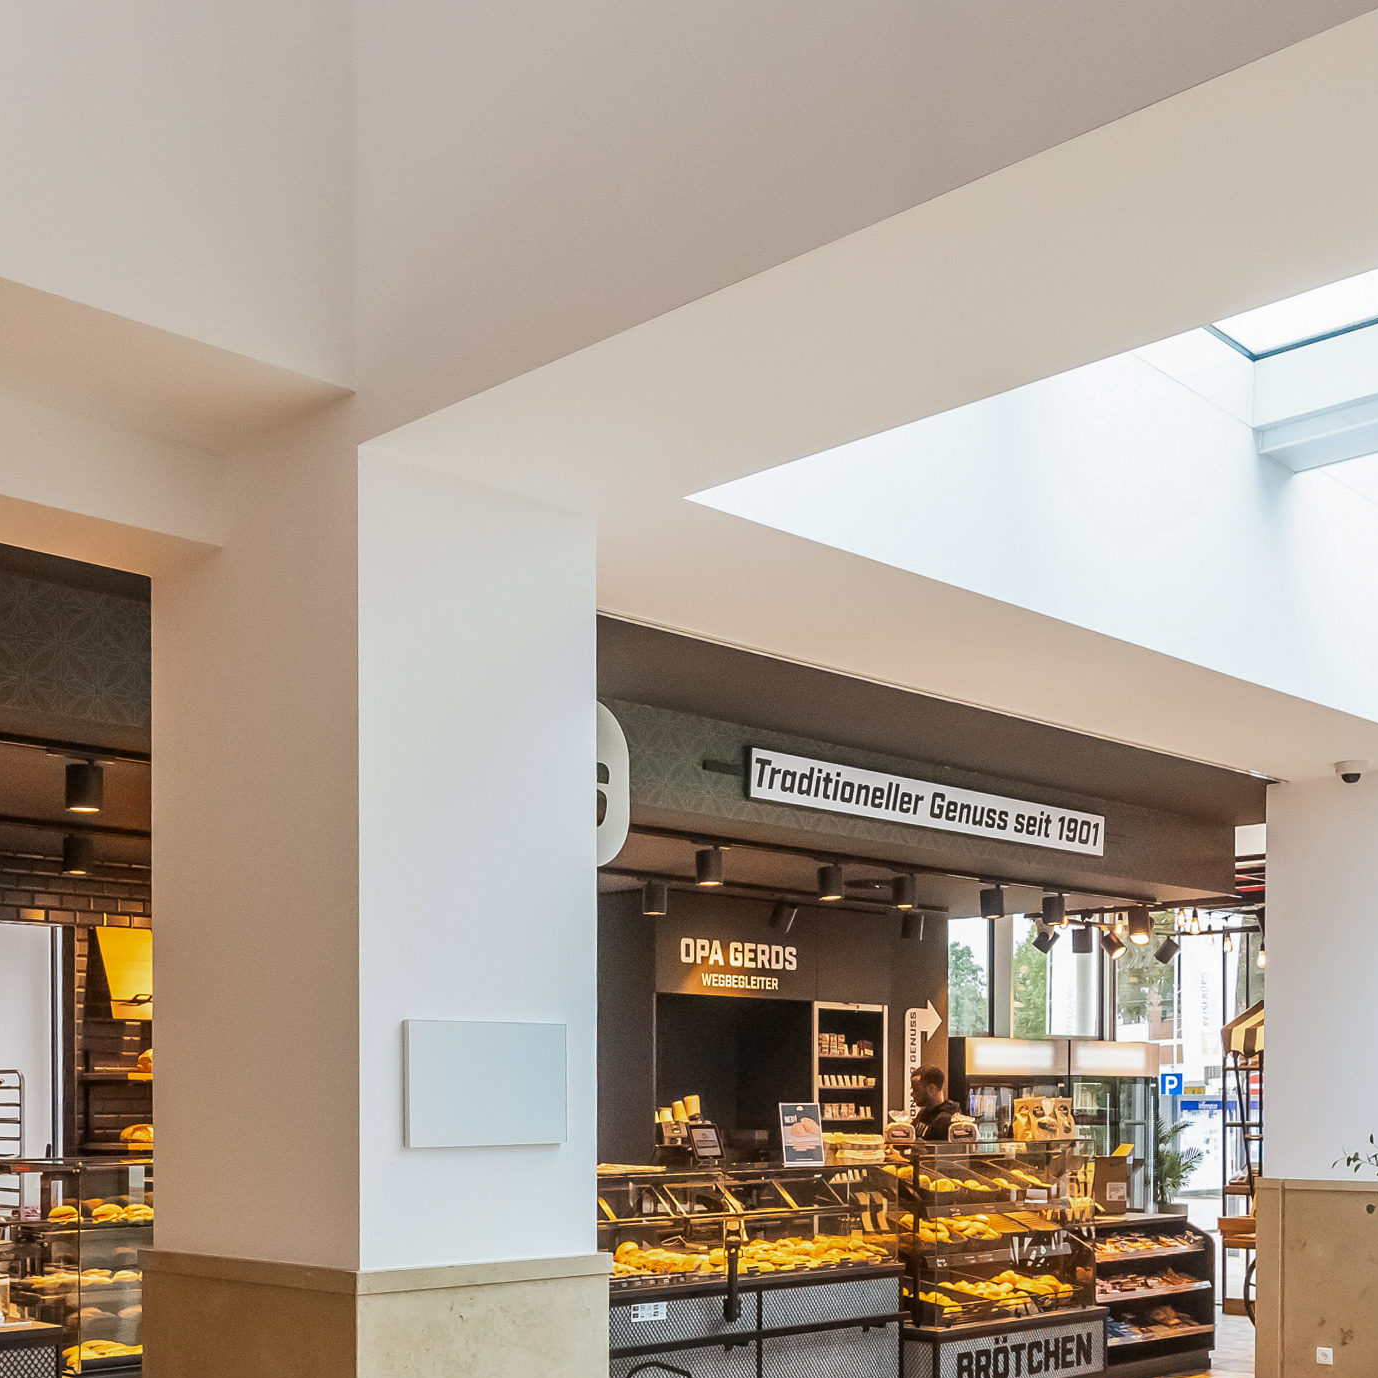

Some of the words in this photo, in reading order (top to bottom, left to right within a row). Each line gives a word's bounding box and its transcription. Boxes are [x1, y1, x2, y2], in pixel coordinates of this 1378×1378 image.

[755, 757, 923, 816] Traditioneller
[929, 792, 1008, 831] Genuss
[1013, 811, 1052, 838] seit
[1057, 816, 1100, 847] 1901
[680, 937, 724, 966] OPA
[729, 941, 797, 971] GERDS
[701, 972, 779, 990] WEGBEGLEITER
[909, 1011, 917, 1063] GENUSS
[1165, 1076, 1179, 1091] P
